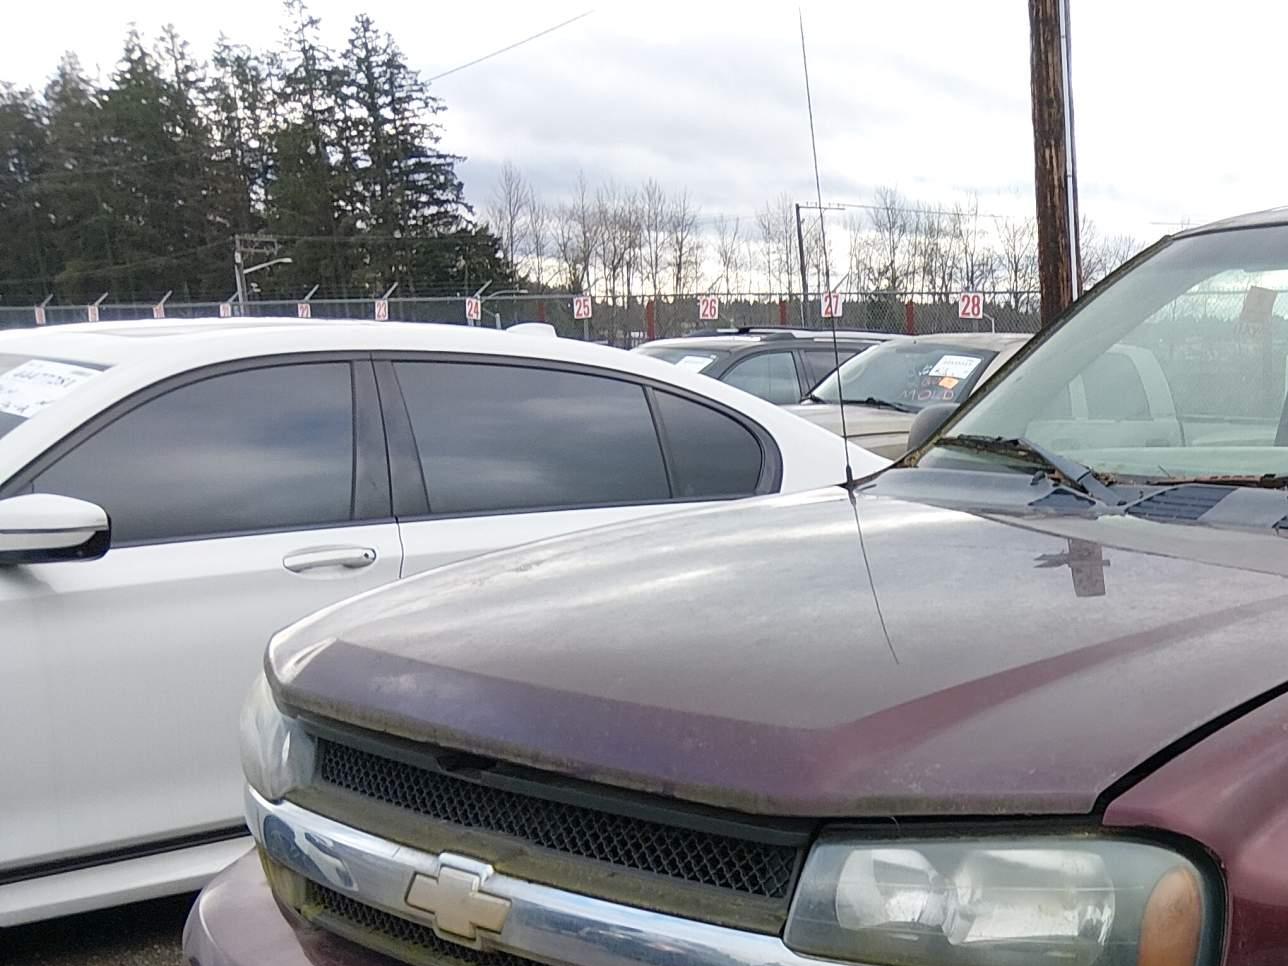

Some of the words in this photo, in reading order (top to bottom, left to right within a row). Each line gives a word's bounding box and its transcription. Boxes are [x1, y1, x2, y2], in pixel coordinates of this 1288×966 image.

[376, 302, 387, 319] 23
[466, 299, 480, 318] 24
[575, 299, 591, 317] 25
[701, 299, 717, 317] 26
[823, 295, 840, 315] 27
[960, 295, 981, 316] 28
